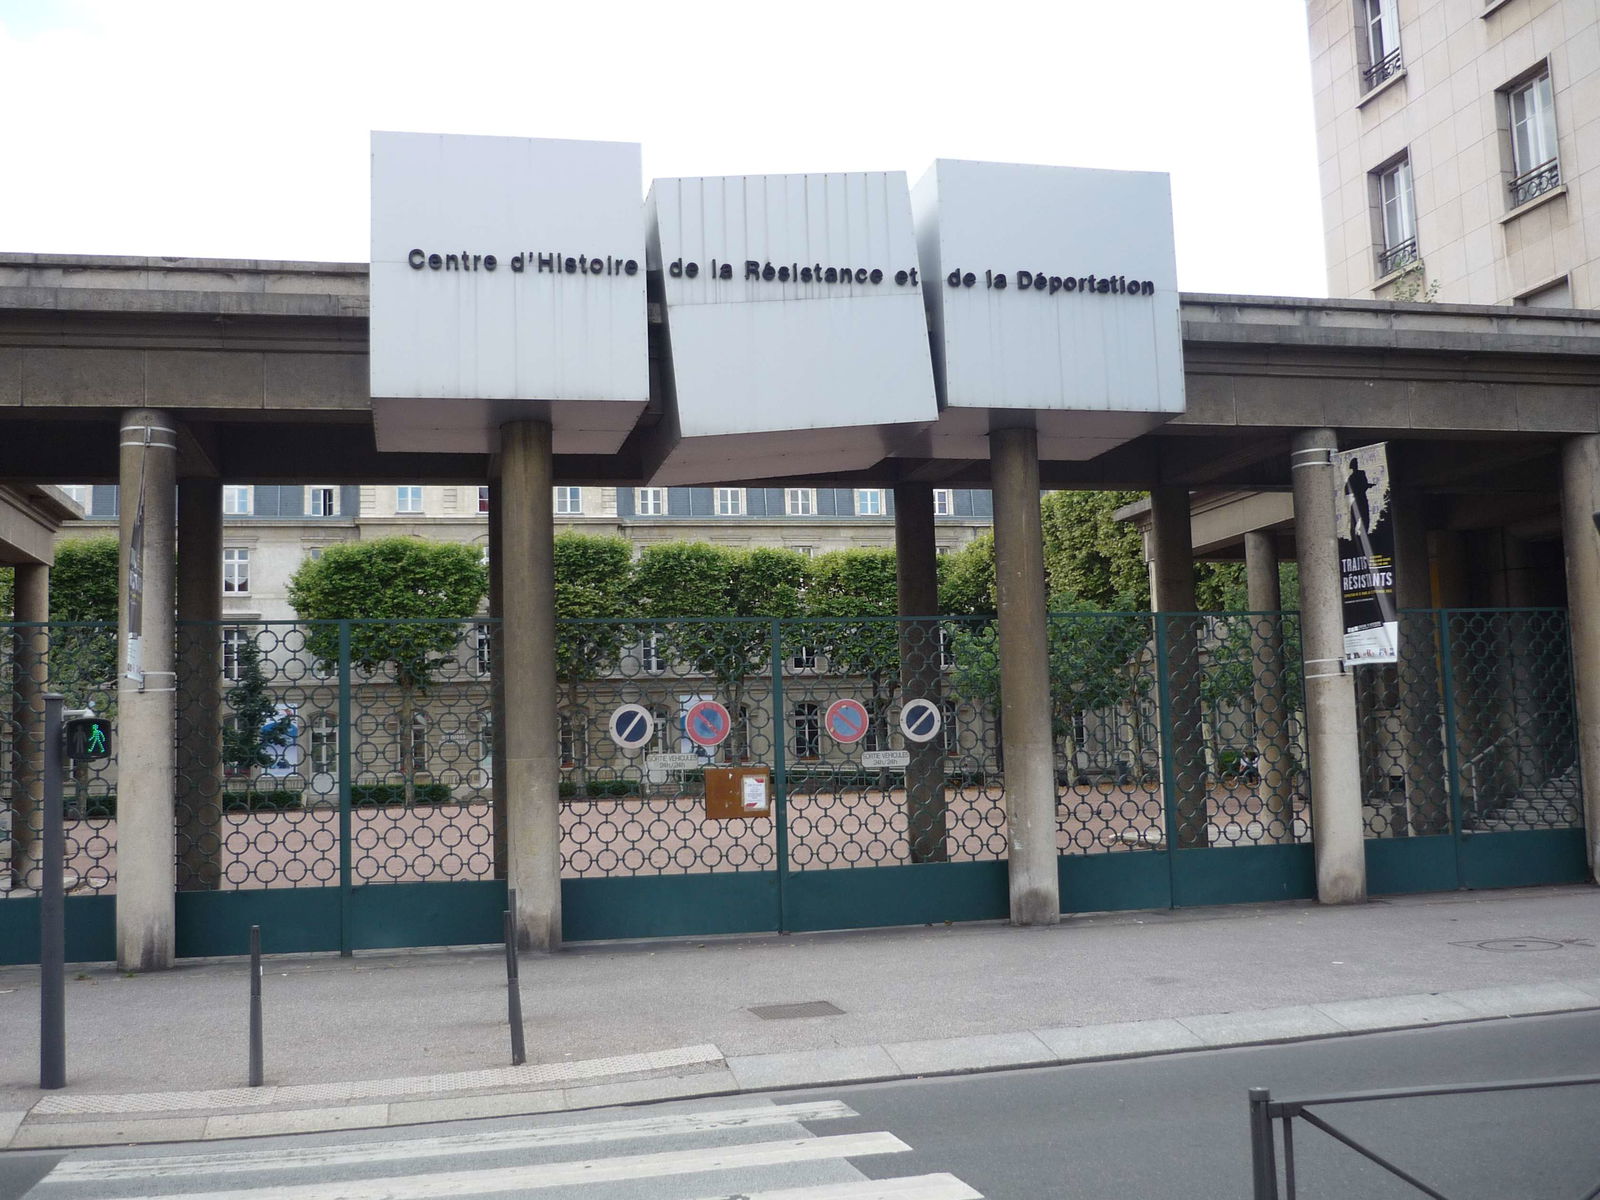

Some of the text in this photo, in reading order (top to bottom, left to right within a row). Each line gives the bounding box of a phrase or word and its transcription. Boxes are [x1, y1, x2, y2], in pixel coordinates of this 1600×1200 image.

[408, 248, 639, 276] Centre d'Histoire
[669, 257, 919, 286] de la Résistance et
[947, 268, 1155, 295] de la Déportation
[1341, 557, 1368, 572] TRAITS
